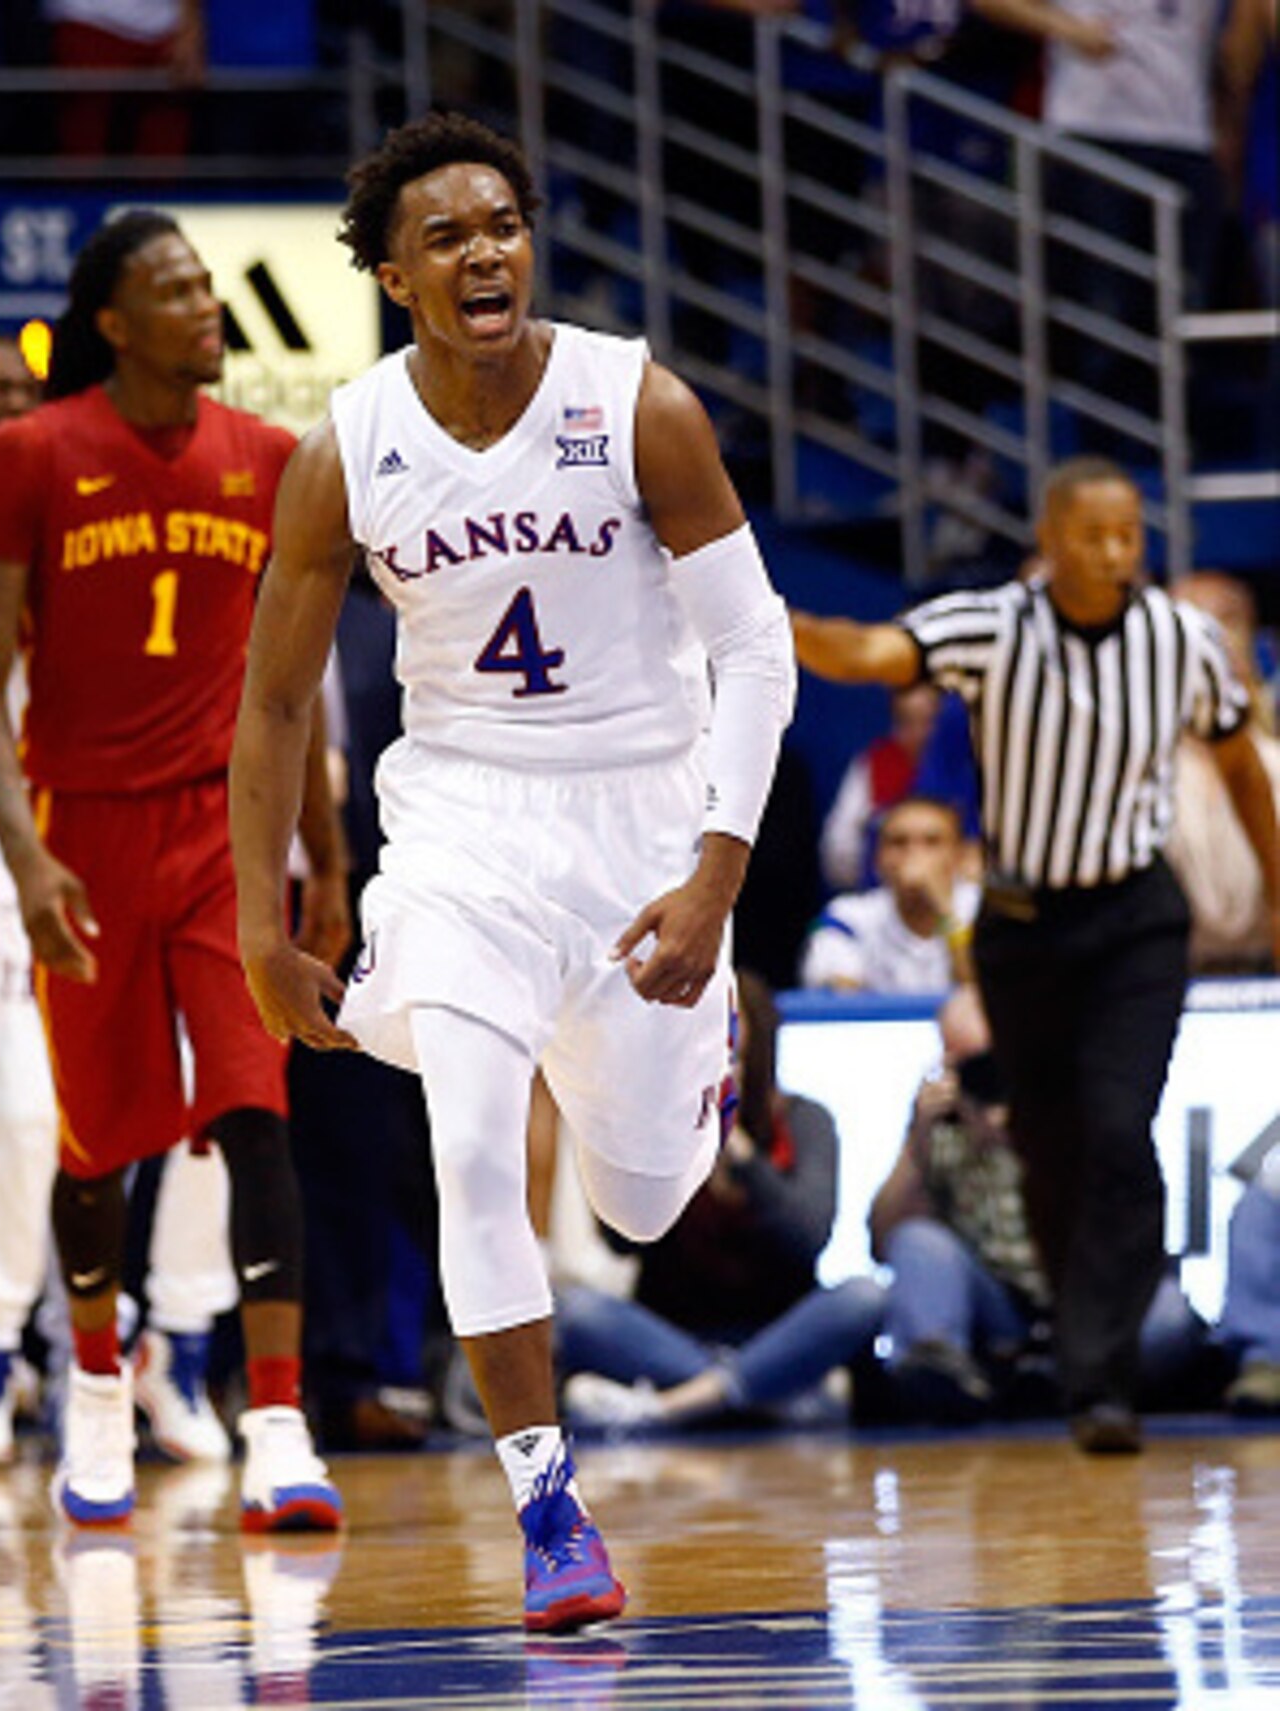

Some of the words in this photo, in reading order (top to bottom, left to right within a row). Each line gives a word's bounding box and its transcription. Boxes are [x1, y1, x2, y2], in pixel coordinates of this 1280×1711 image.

[62, 511, 157, 571] IOWA
[370, 512, 622, 583] KANSAS
[144, 570, 178, 656] 1
[474, 586, 569, 698] 4
